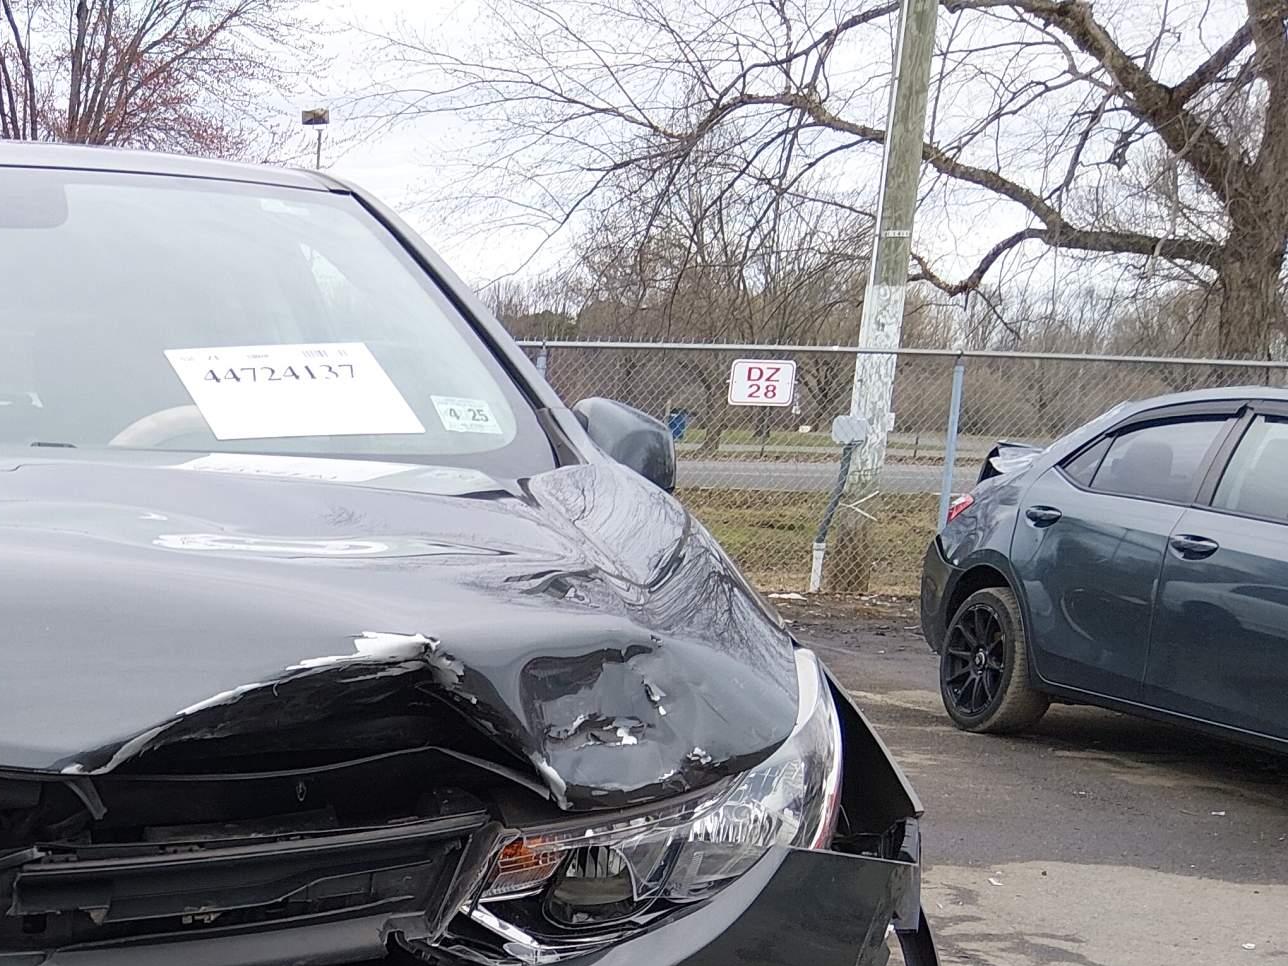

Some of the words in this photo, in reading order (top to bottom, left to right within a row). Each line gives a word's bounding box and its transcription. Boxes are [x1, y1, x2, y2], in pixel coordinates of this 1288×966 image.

[203, 364, 355, 383] 44724137
[746, 366, 782, 382] DZ
[746, 383, 778, 399] 28
[466, 408, 489, 422] 25
